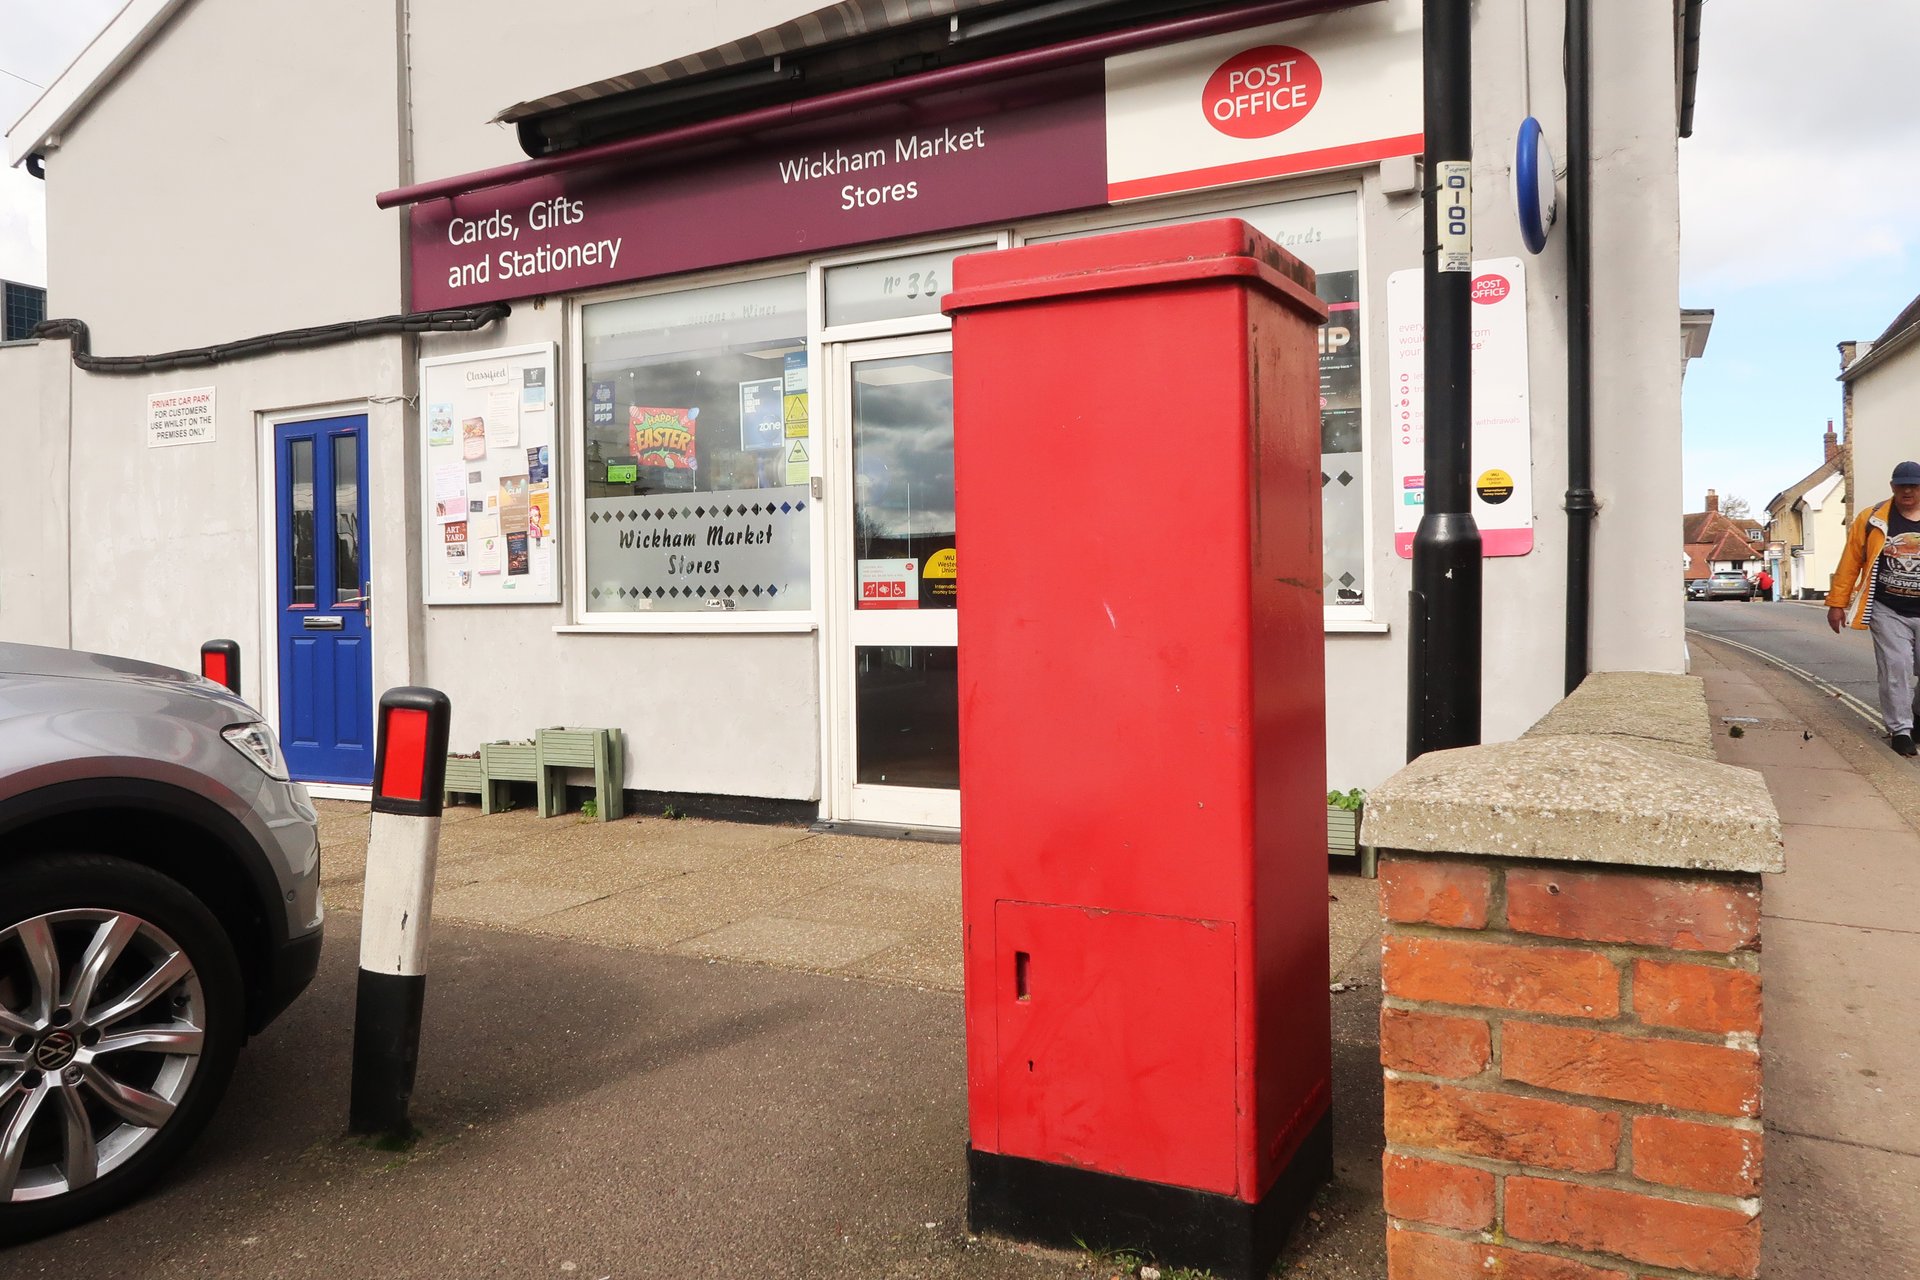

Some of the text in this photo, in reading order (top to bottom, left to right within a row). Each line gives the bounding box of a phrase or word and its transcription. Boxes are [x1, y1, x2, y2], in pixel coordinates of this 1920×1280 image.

[1229, 60, 1297, 94] POST
[1213, 84, 1308, 121] OFFICE
[779, 126, 985, 184] Wickham Market
[841, 181, 918, 210] Stores
[448, 196, 584, 246] Cards, Gifts
[1275, 226, 1322, 246] Cards
[448, 237, 622, 288] and Stationery
[906, 270, 938, 299] 36
[1471, 287, 1506, 299] OFFICE
[1476, 279, 1502, 290] POST
[466, 367, 506, 382] Classified
[151, 394, 210, 408] PRIVATE CAR PARK
[154, 405, 208, 419] FOR CUSTOMERS
[647, 413, 677, 426] HAPPY
[150, 415, 212, 430] USE WHILST ON THE
[758, 420, 781, 432] zone
[156, 427, 206, 440] PREMISES ONLY
[635, 427, 692, 451] EASTER
[446, 526, 460, 534] ART
[446, 533, 465, 542] YARD
[619, 523, 773, 549] Wickham Market
[667, 554, 721, 575] Stores
